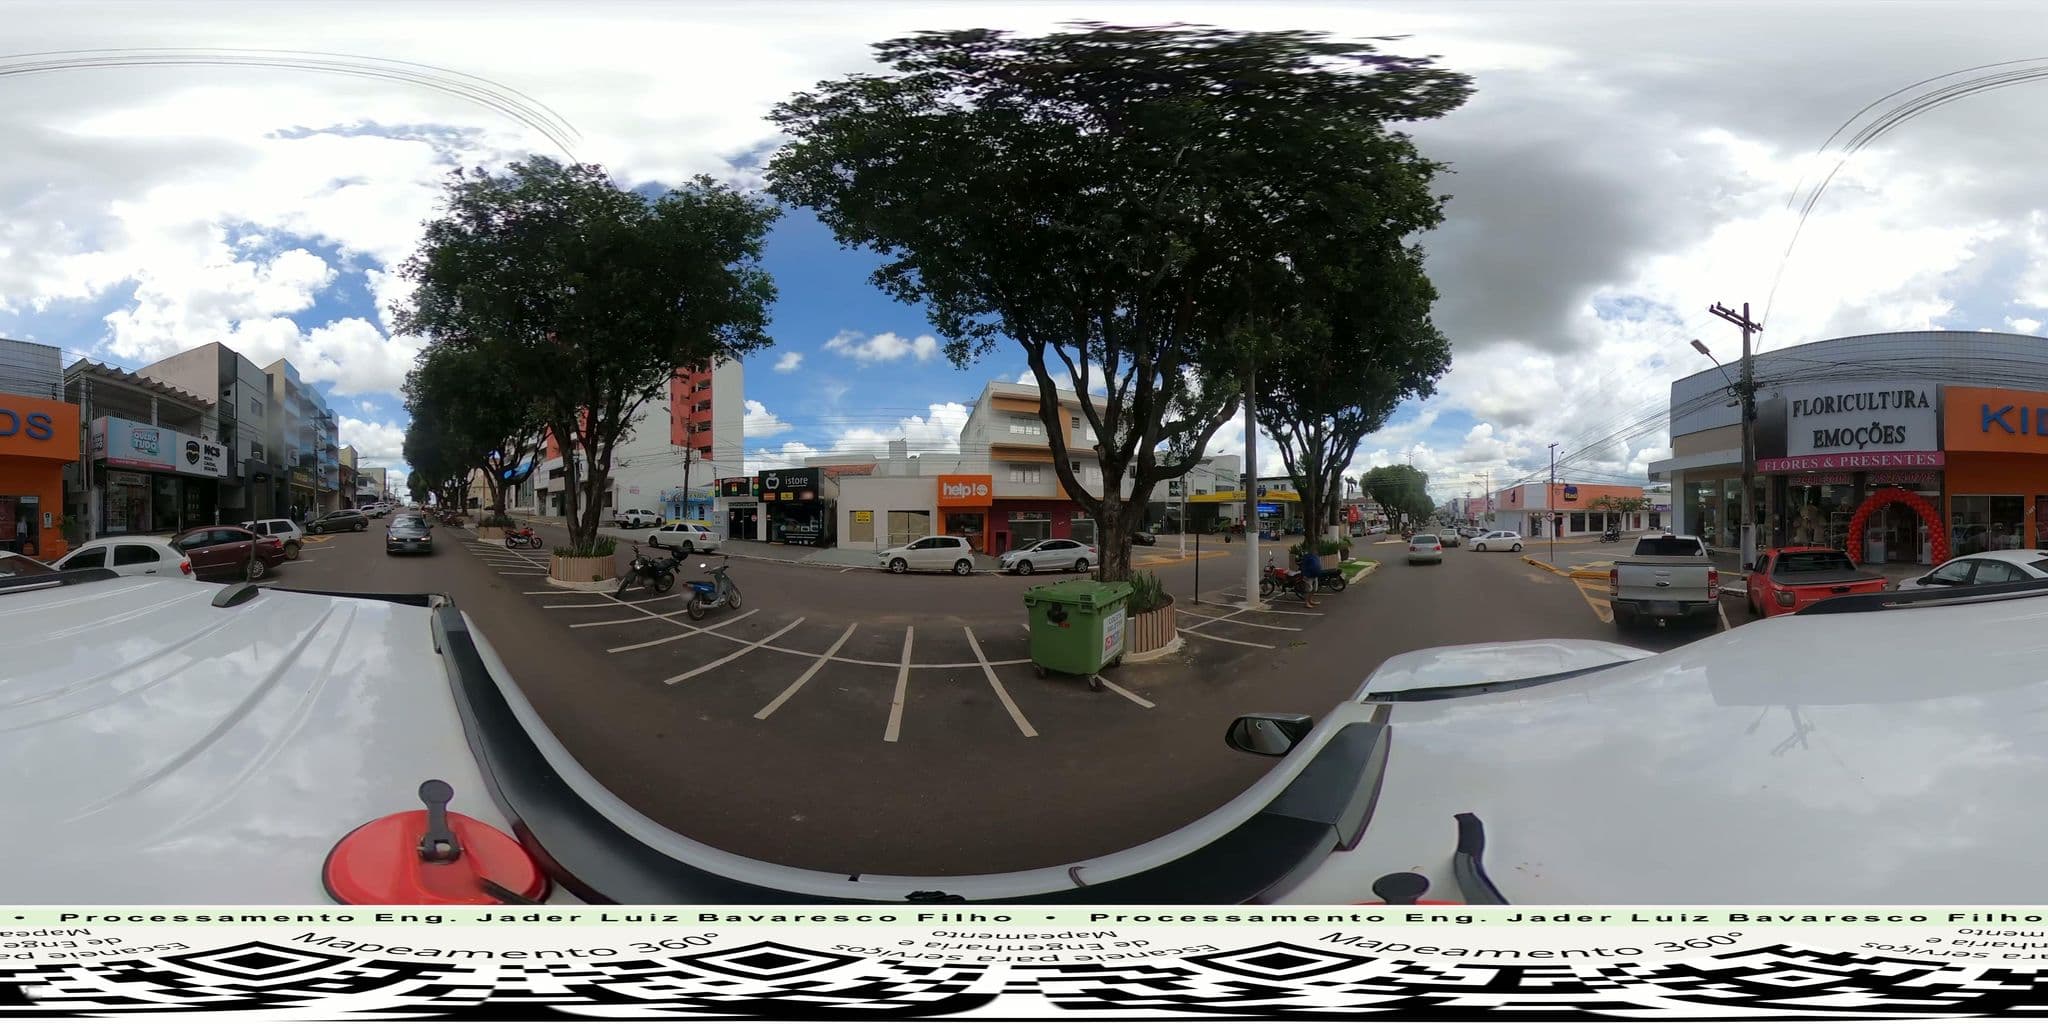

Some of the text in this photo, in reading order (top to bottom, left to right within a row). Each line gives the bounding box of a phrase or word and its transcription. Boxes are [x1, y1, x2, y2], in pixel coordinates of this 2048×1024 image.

[1793, 390, 1930, 417] FLORICULTURA
[1813, 422, 1906, 450] EMOÇÕES
[1764, 454, 1937, 471] FLORES & PRESENTES
[785, 476, 808, 486] istore
[943, 483, 976, 498] help!
